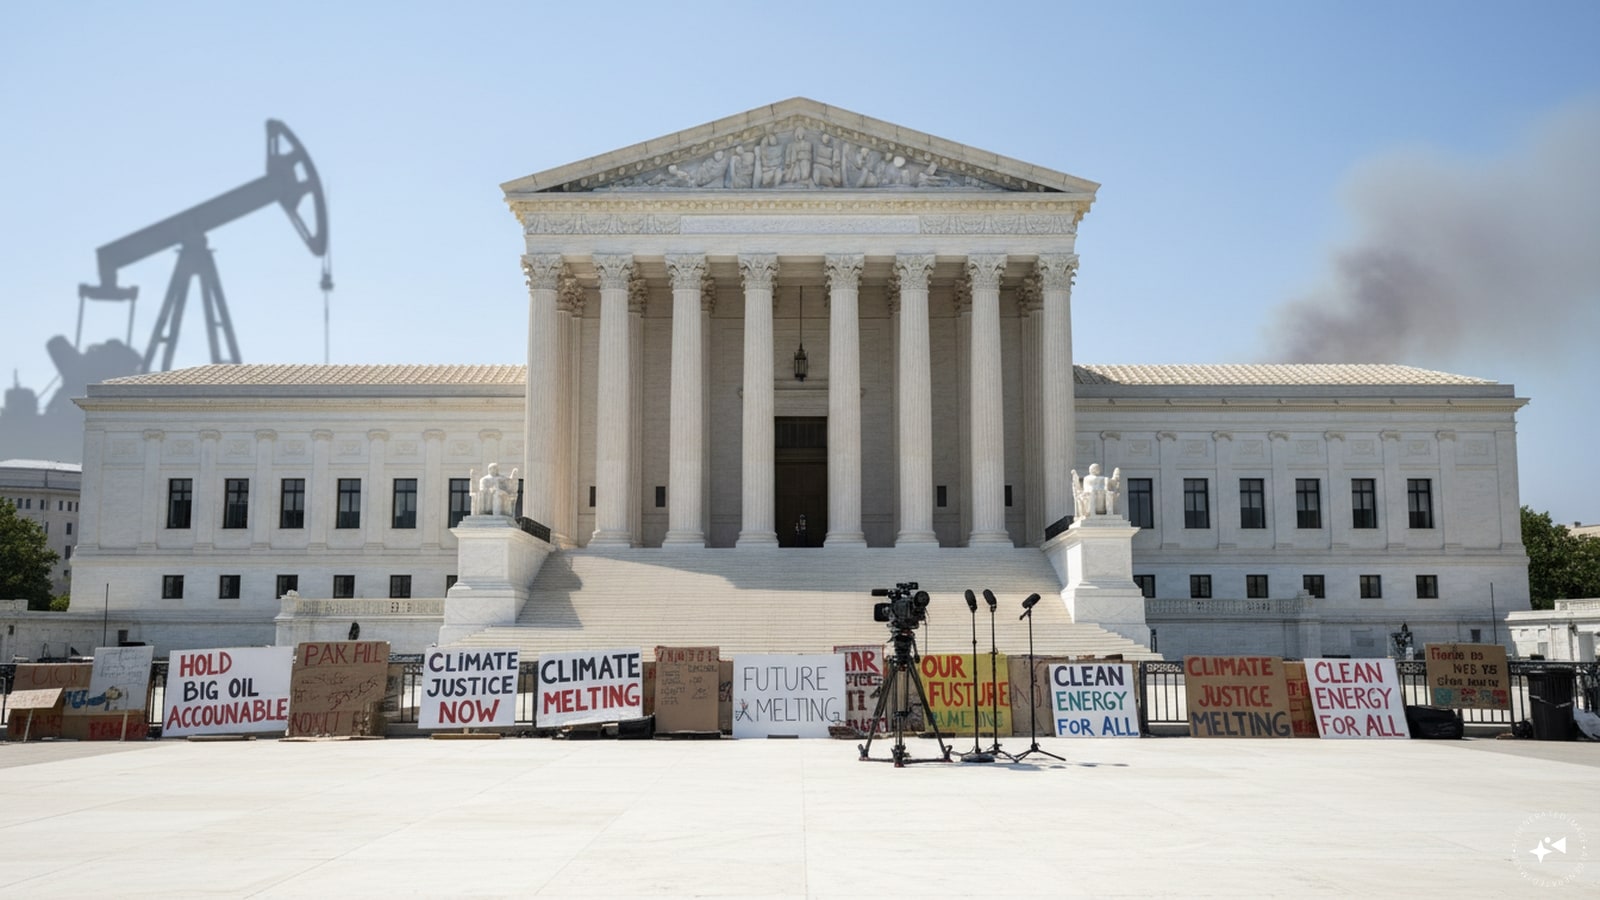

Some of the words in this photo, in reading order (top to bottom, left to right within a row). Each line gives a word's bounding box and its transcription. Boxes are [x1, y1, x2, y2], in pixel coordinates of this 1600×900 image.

[180, 652, 232, 677] HOLD
[541, 653, 640, 684] CLIMATE
[921, 655, 967, 678] OUR
[1187, 657, 1273, 677] CLIMATE
[1314, 661, 1384, 684] CLEAN
[427, 676, 514, 697] JUSTICE
[744, 666, 828, 691] FUTURE
[1054, 666, 1124, 687] CLEAN
[184, 680, 218, 702] BIG
[229, 678, 259, 698] OIL
[544, 683, 640, 714] MELTING
[1056, 691, 1127, 711] ENERGY
[1198, 684, 1272, 707] JUSTICE
[1315, 687, 1392, 710] ENERGY
[166, 698, 288, 730] ACCOUNABLE
[438, 699, 500, 724] NOW
[757, 697, 839, 722] MELTING
[1058, 718, 1095, 736] FOR
[1102, 716, 1139, 737] ALL
[1191, 711, 1291, 737] MELTING
[1320, 715, 1361, 736] FOR
[1366, 714, 1405, 737] ALL
